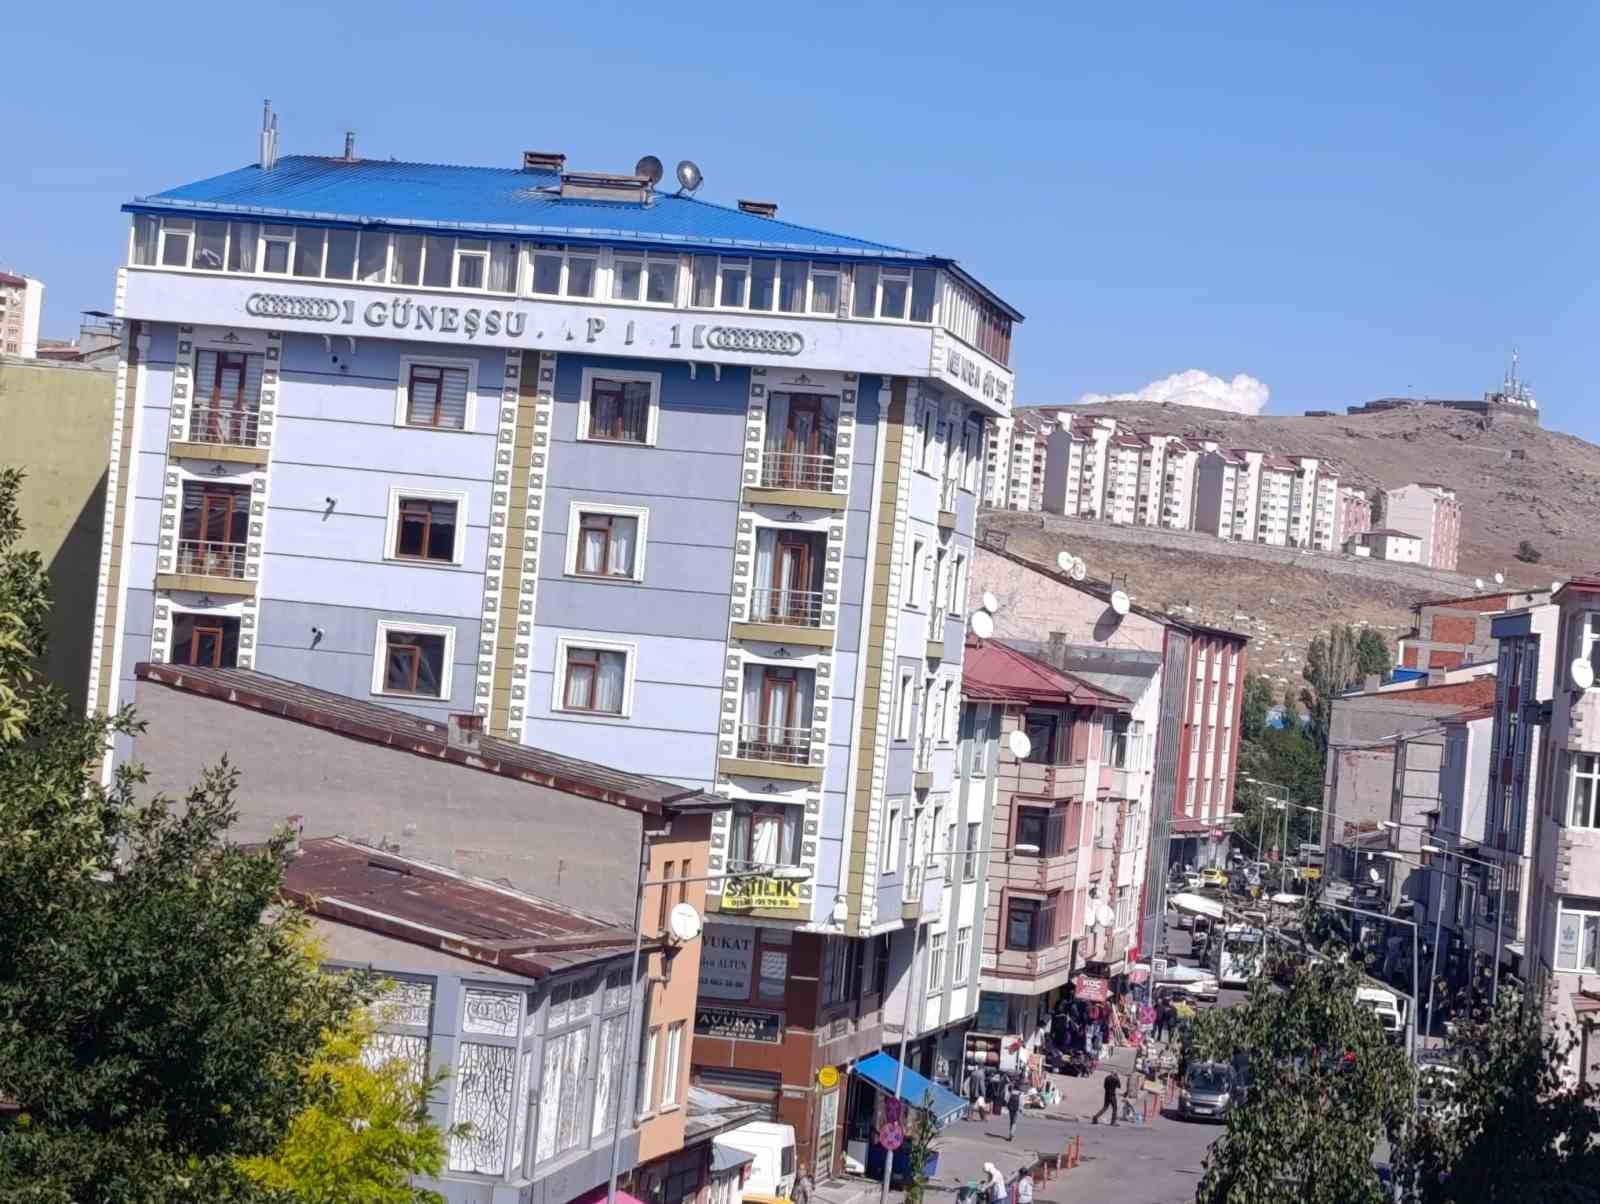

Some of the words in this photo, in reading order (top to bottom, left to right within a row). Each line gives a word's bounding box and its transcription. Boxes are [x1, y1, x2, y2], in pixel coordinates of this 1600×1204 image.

[364, 297, 529, 340] GÜNEŞSU
[725, 878, 797, 897] SATILIK
[703, 935, 752, 951] VUKAT
[698, 1014, 767, 1030] AVUKAT
